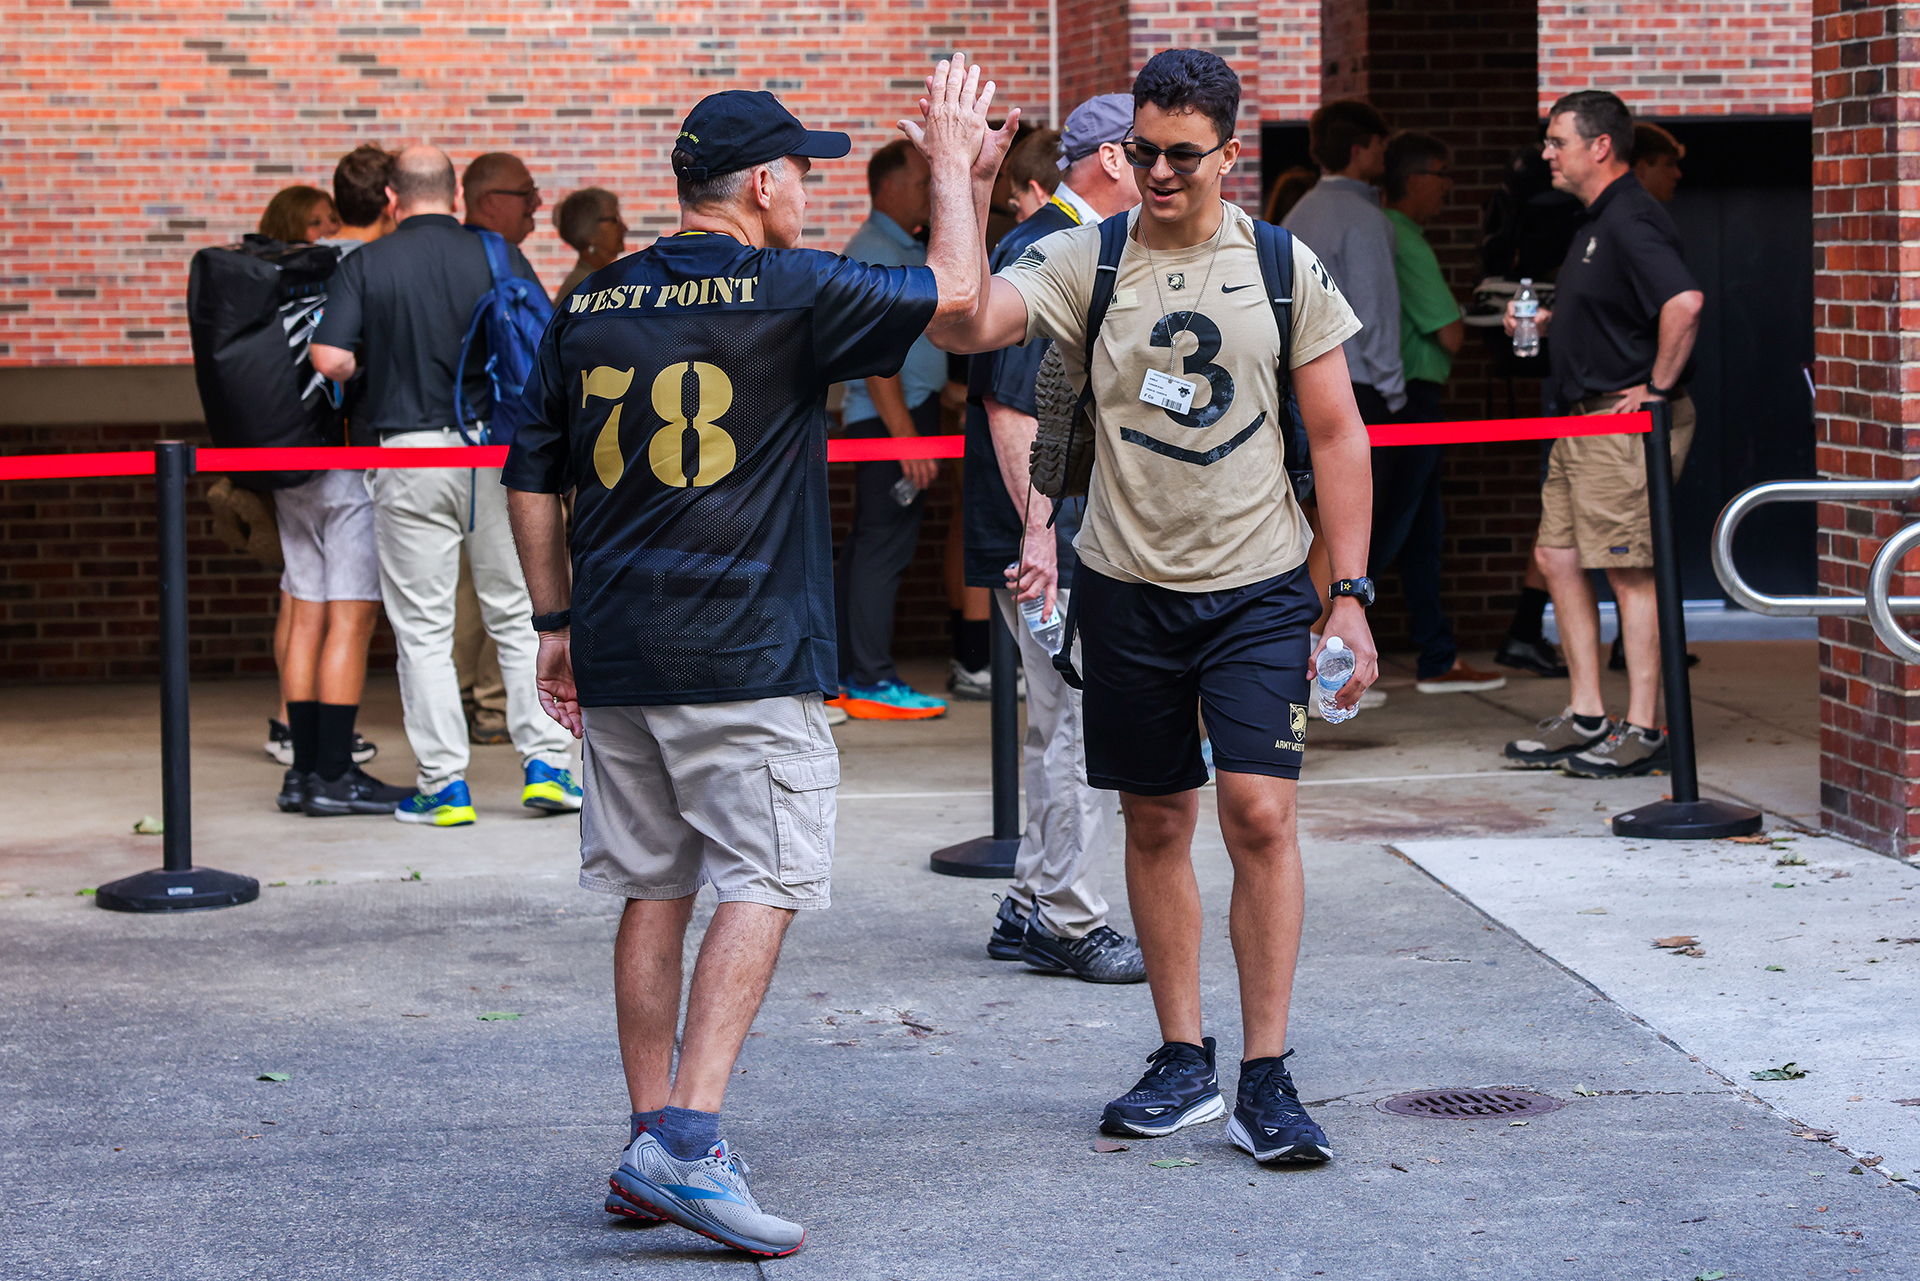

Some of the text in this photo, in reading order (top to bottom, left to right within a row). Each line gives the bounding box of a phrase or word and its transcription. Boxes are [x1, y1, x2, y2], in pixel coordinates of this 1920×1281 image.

[569, 276, 759, 314] WEST POINT
[1150, 311, 1235, 428] 3
[581, 361, 737, 490] 78
[1274, 739, 1291, 750] ARMY
